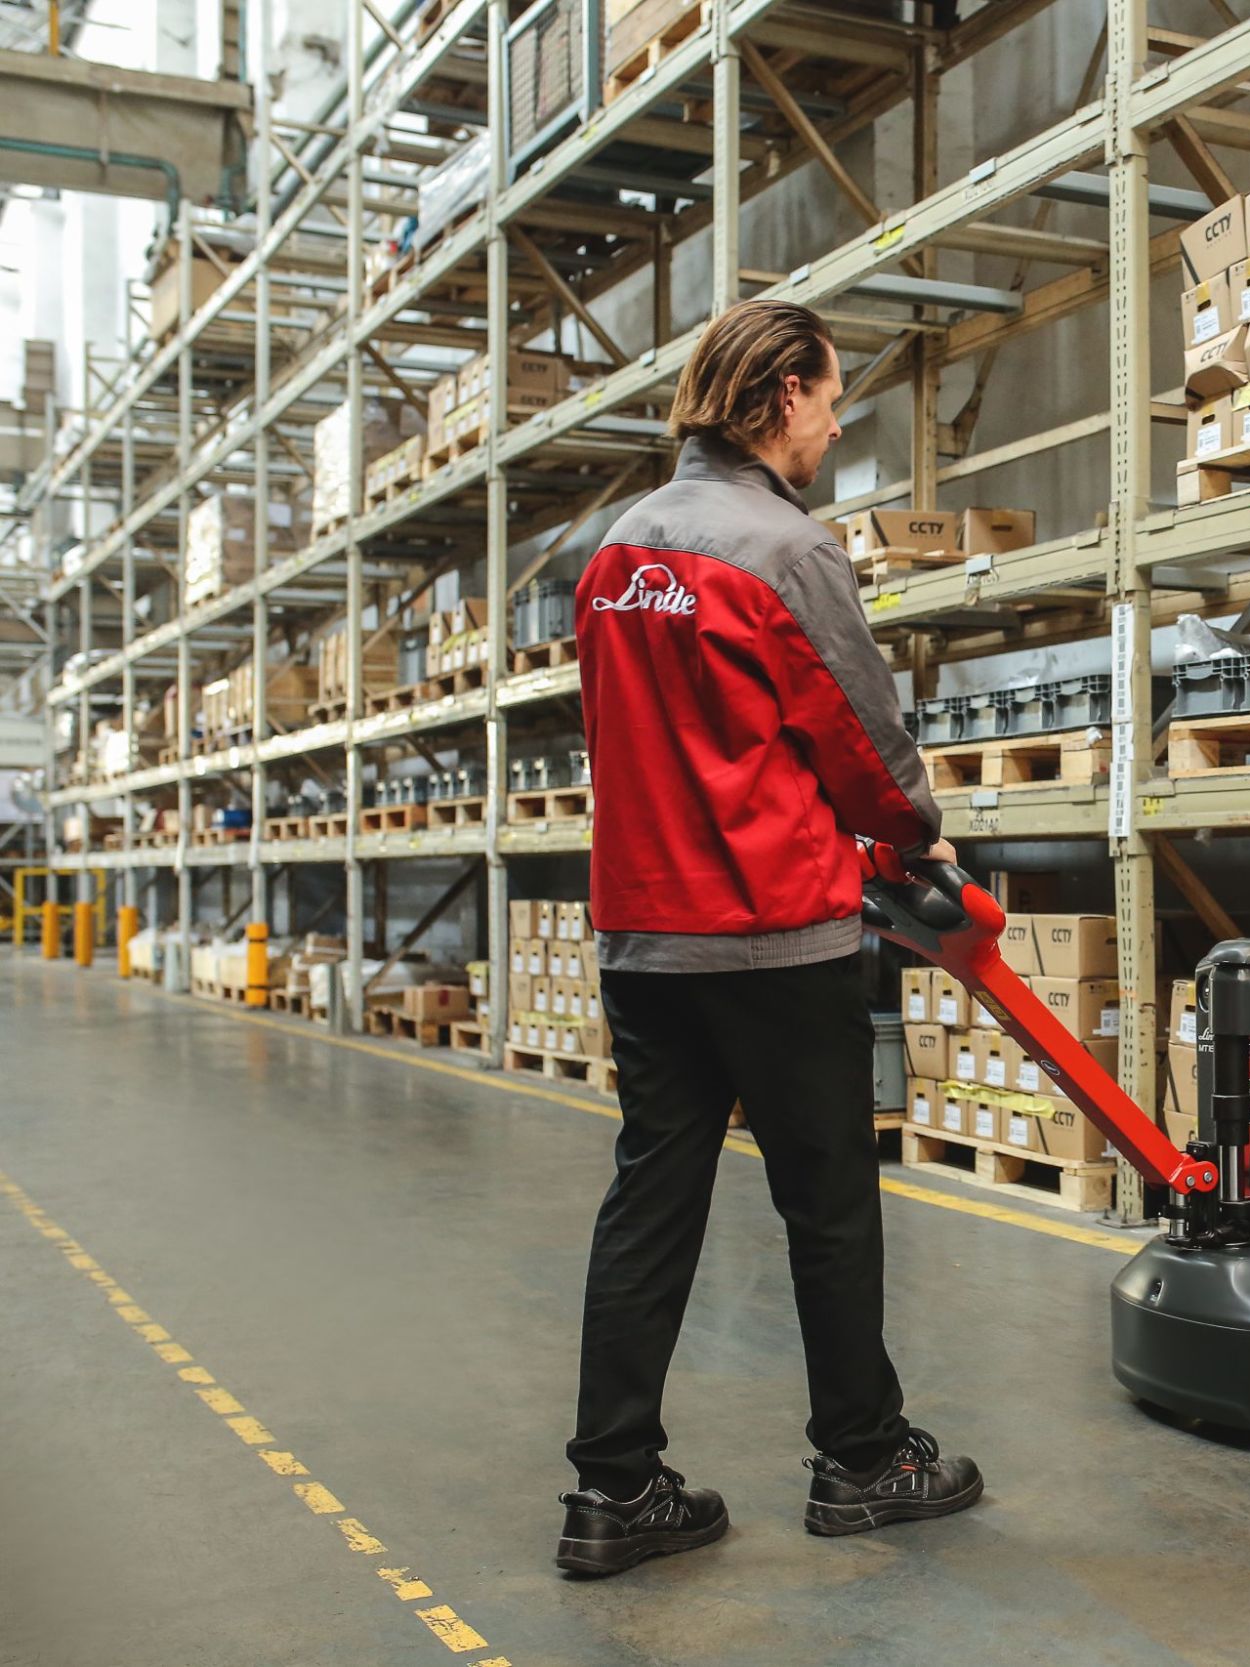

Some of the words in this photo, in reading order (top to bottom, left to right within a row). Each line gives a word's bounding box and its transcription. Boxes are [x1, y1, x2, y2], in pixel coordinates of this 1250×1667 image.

[1205, 213, 1232, 243] CCTY
[908, 521, 944, 535] CCTY
[592, 563, 697, 615] Linde
[1007, 927, 1027, 941] CCTY
[1051, 928, 1072, 943] CCTY
[1048, 992, 1071, 1008] CCTY
[918, 1035, 937, 1049] CCTY
[1053, 1110, 1076, 1128] CCTY
